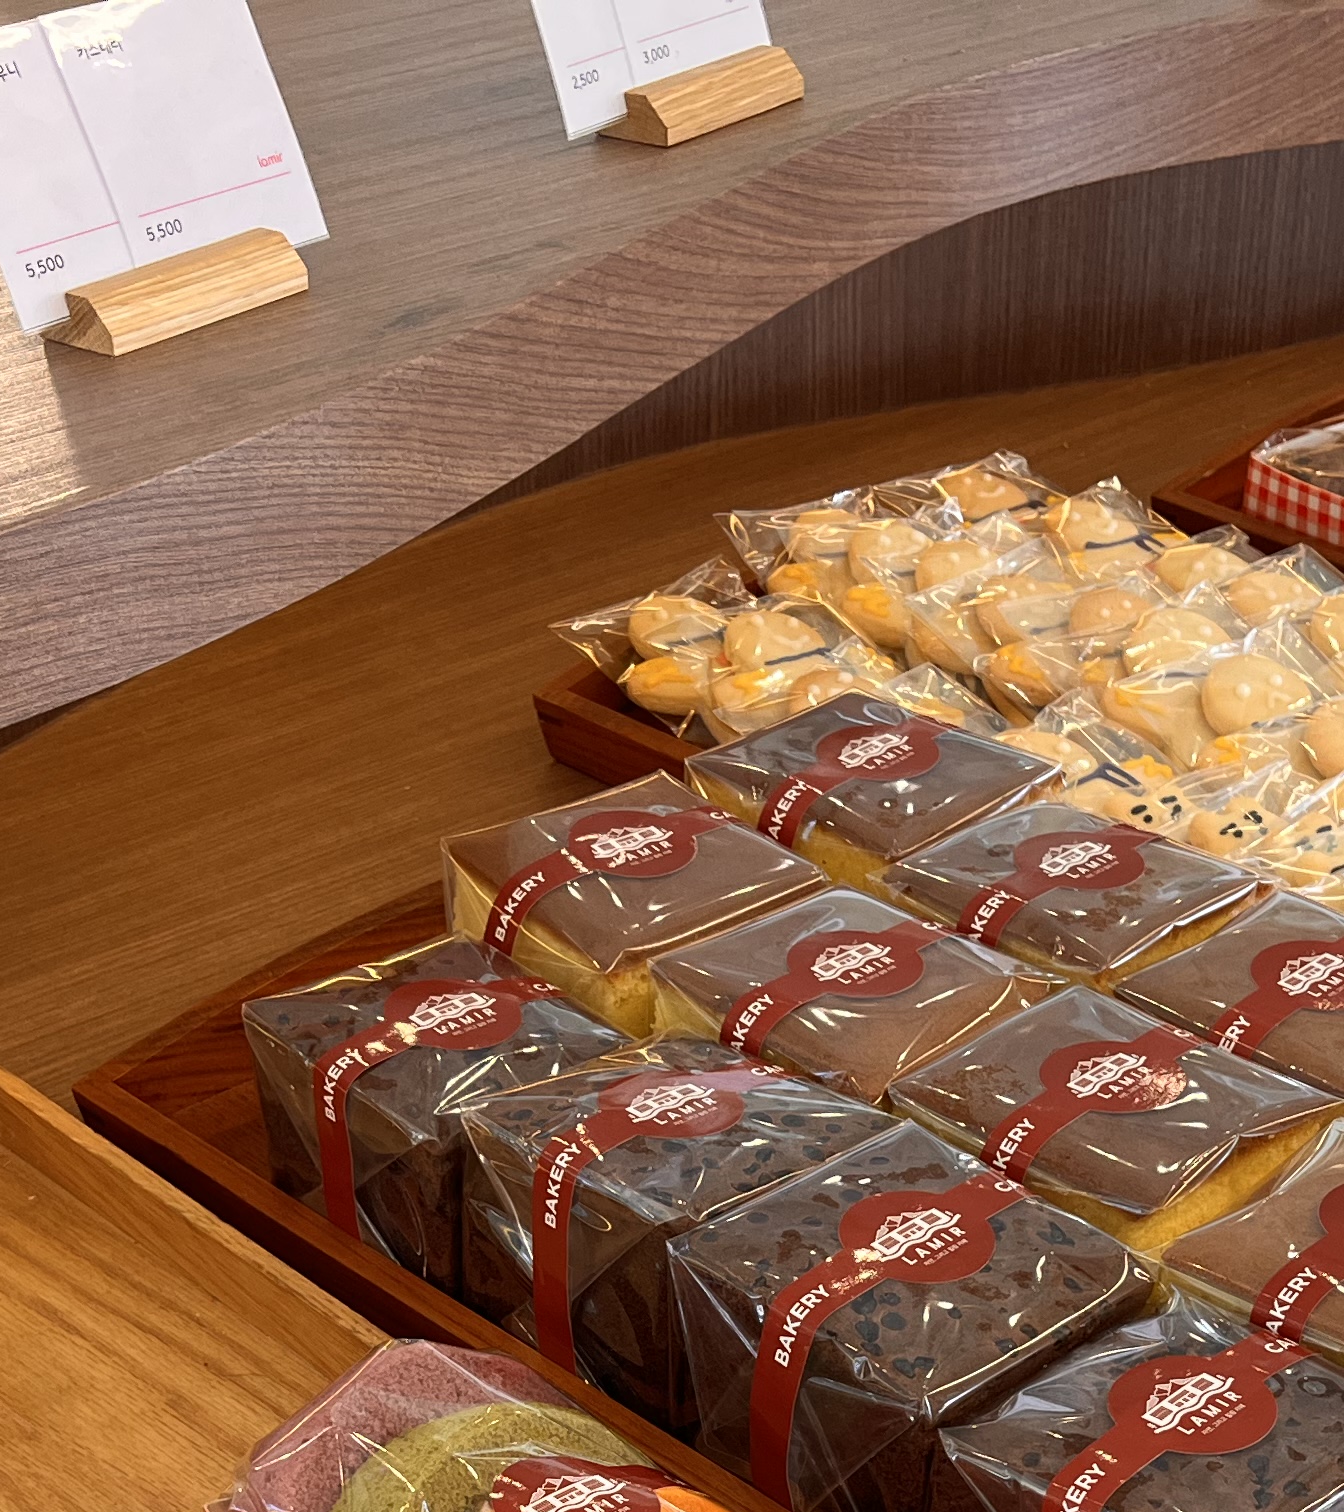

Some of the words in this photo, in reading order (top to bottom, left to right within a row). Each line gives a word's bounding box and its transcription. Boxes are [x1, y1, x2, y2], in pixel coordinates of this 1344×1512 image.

[643, 44, 670, 65] 3,000
[571, 69, 599, 90] 2,500
[257, 152, 284, 168] lamir
[146, 218, 182, 242] 5,500
[25, 254, 64, 279] 5,500
[768, 780, 807, 839] AKERY
[1066, 853, 1117, 879] LAMIR
[494, 872, 546, 942] BAKERY
[968, 890, 1010, 941] AKERY
[838, 956, 895, 984] LAMIR
[433, 1008, 498, 1035] LAMIR
[731, 994, 774, 1052] AKERY
[1218, 1015, 1251, 1053] ERY
[324, 1048, 365, 1122] BAKERY
[653, 1096, 718, 1125] LAMIR
[993, 1118, 1036, 1174] KERY
[544, 1141, 582, 1228] BAKERY
[901, 1226, 967, 1265] LAMIR
[1266, 1267, 1318, 1337] AKERY
[773, 1283, 831, 1368] BAKERY
[1176, 1391, 1243, 1435] LAMIR
